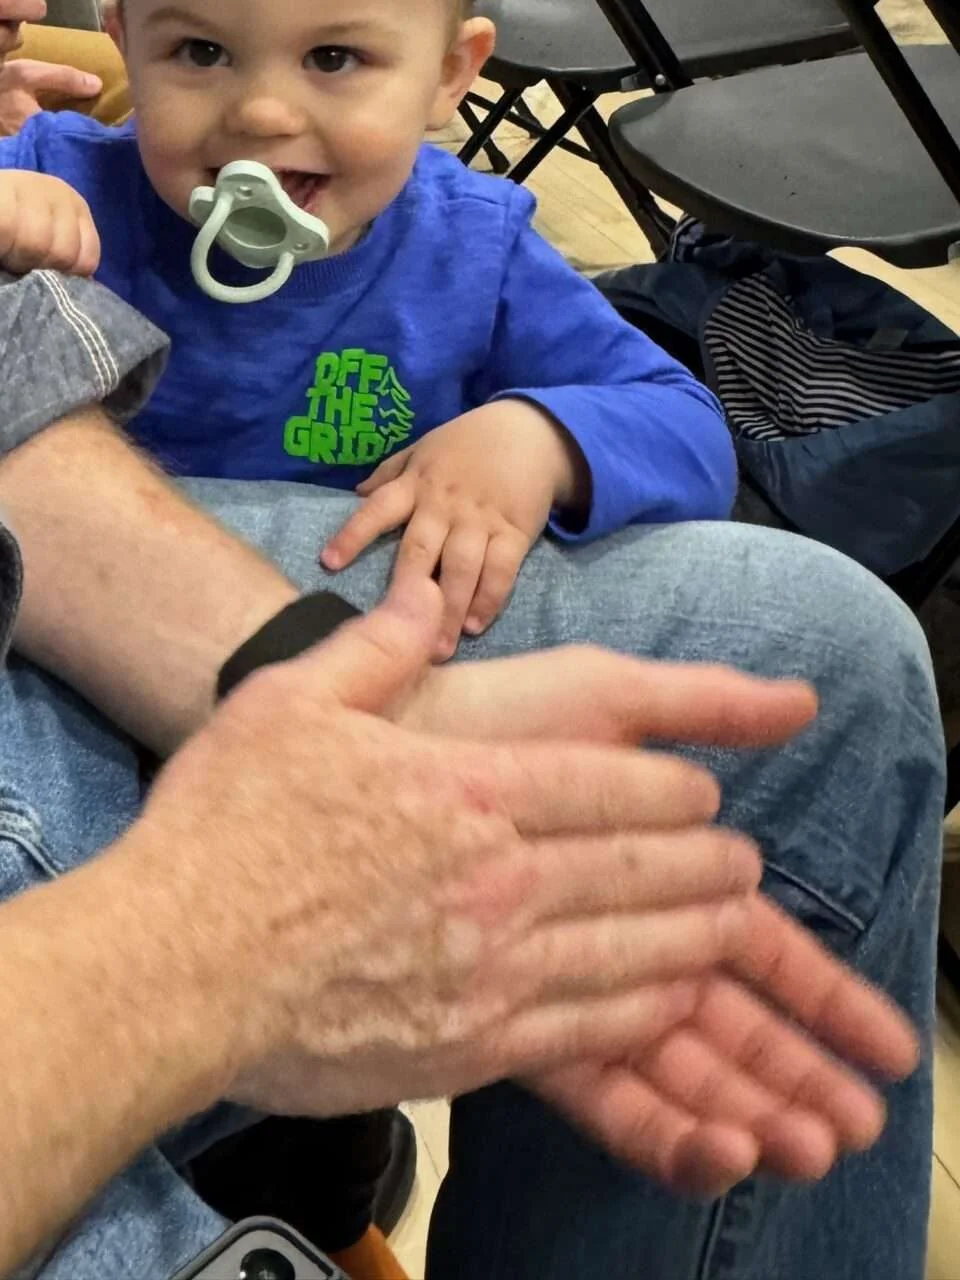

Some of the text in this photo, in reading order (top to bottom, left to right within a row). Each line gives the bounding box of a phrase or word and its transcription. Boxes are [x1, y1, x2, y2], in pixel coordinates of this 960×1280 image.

[314, 348, 388, 393] OFF
[306, 385, 378, 433] THE
[284, 415, 386, 465] GRID
